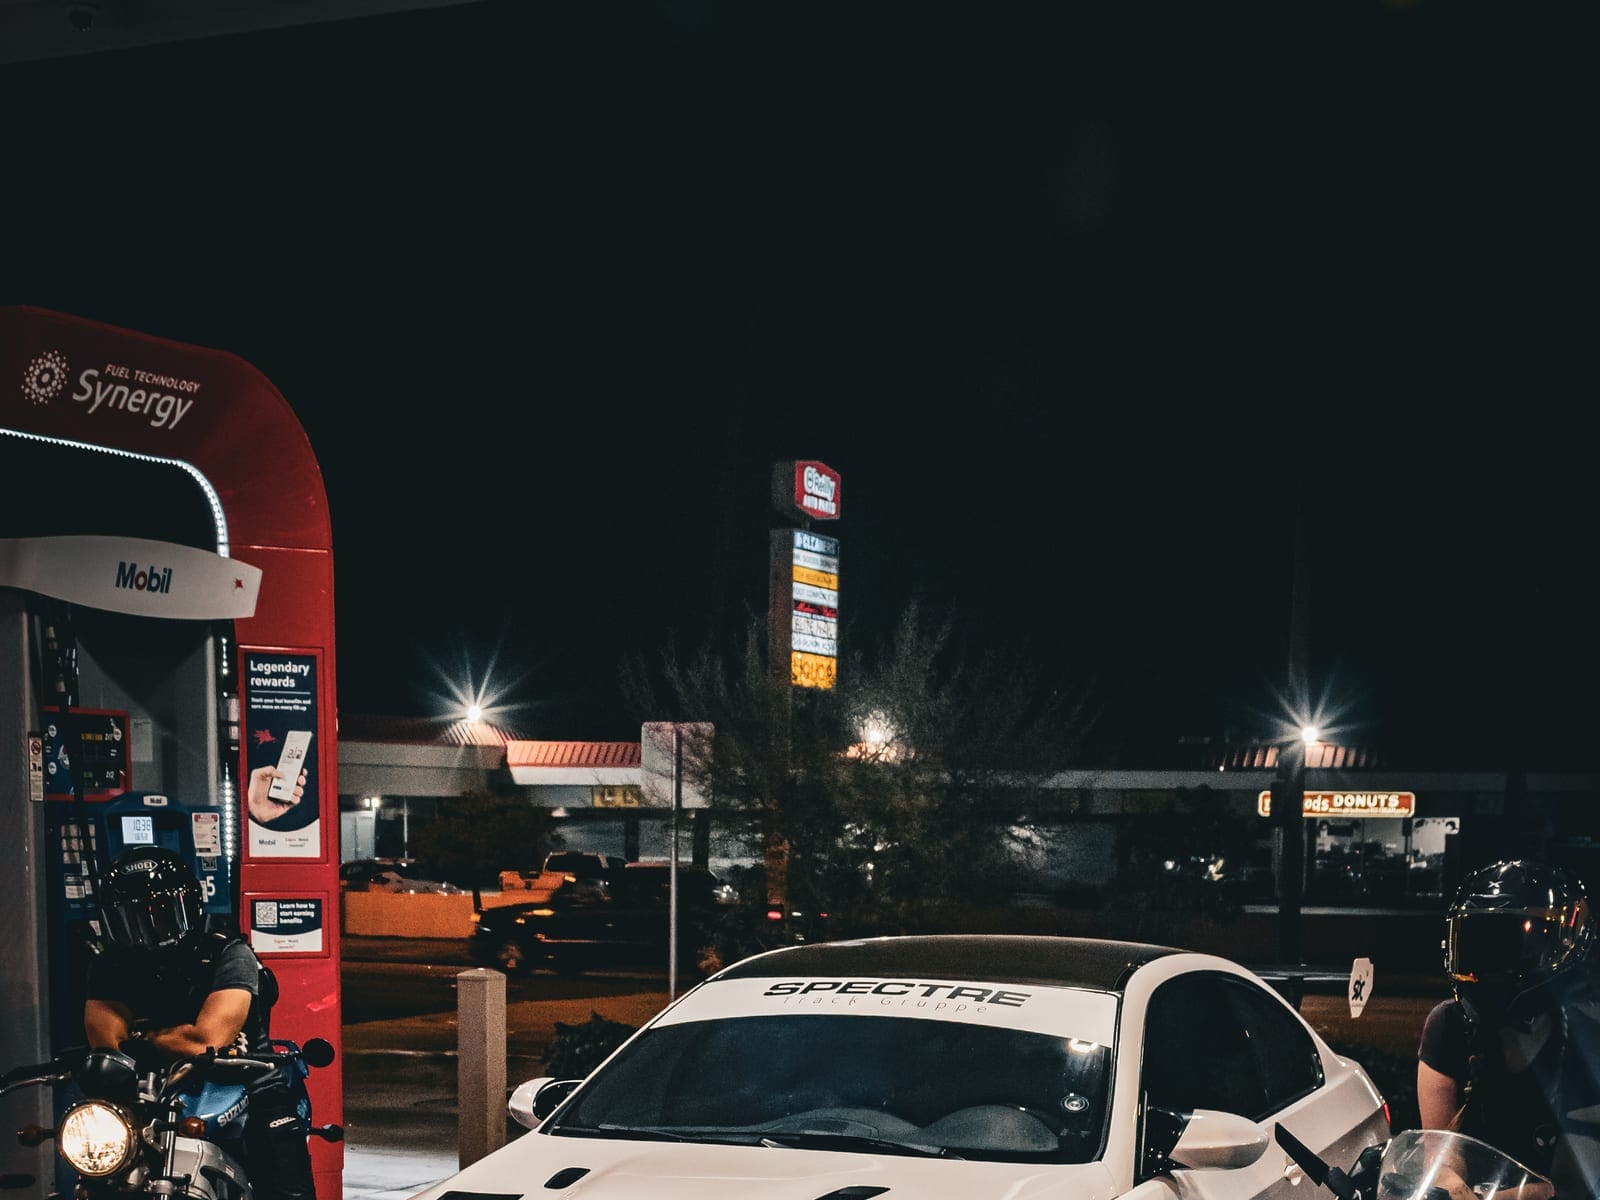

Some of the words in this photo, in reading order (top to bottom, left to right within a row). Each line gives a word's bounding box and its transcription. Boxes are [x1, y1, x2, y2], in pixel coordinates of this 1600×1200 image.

[105, 363, 130, 379] FUEL
[134, 370, 201, 393] TECHNOLOGY
[72, 368, 194, 430] Synergy
[115, 561, 172, 594] Mobil
[250, 660, 310, 676] Legendary
[250, 675, 296, 688] rewards
[1333, 794, 1399, 807] DONUTS
[125, 861, 153, 872] SHOEI
[206, 875, 216, 896] 5
[763, 981, 1032, 1008] SPECTRE
